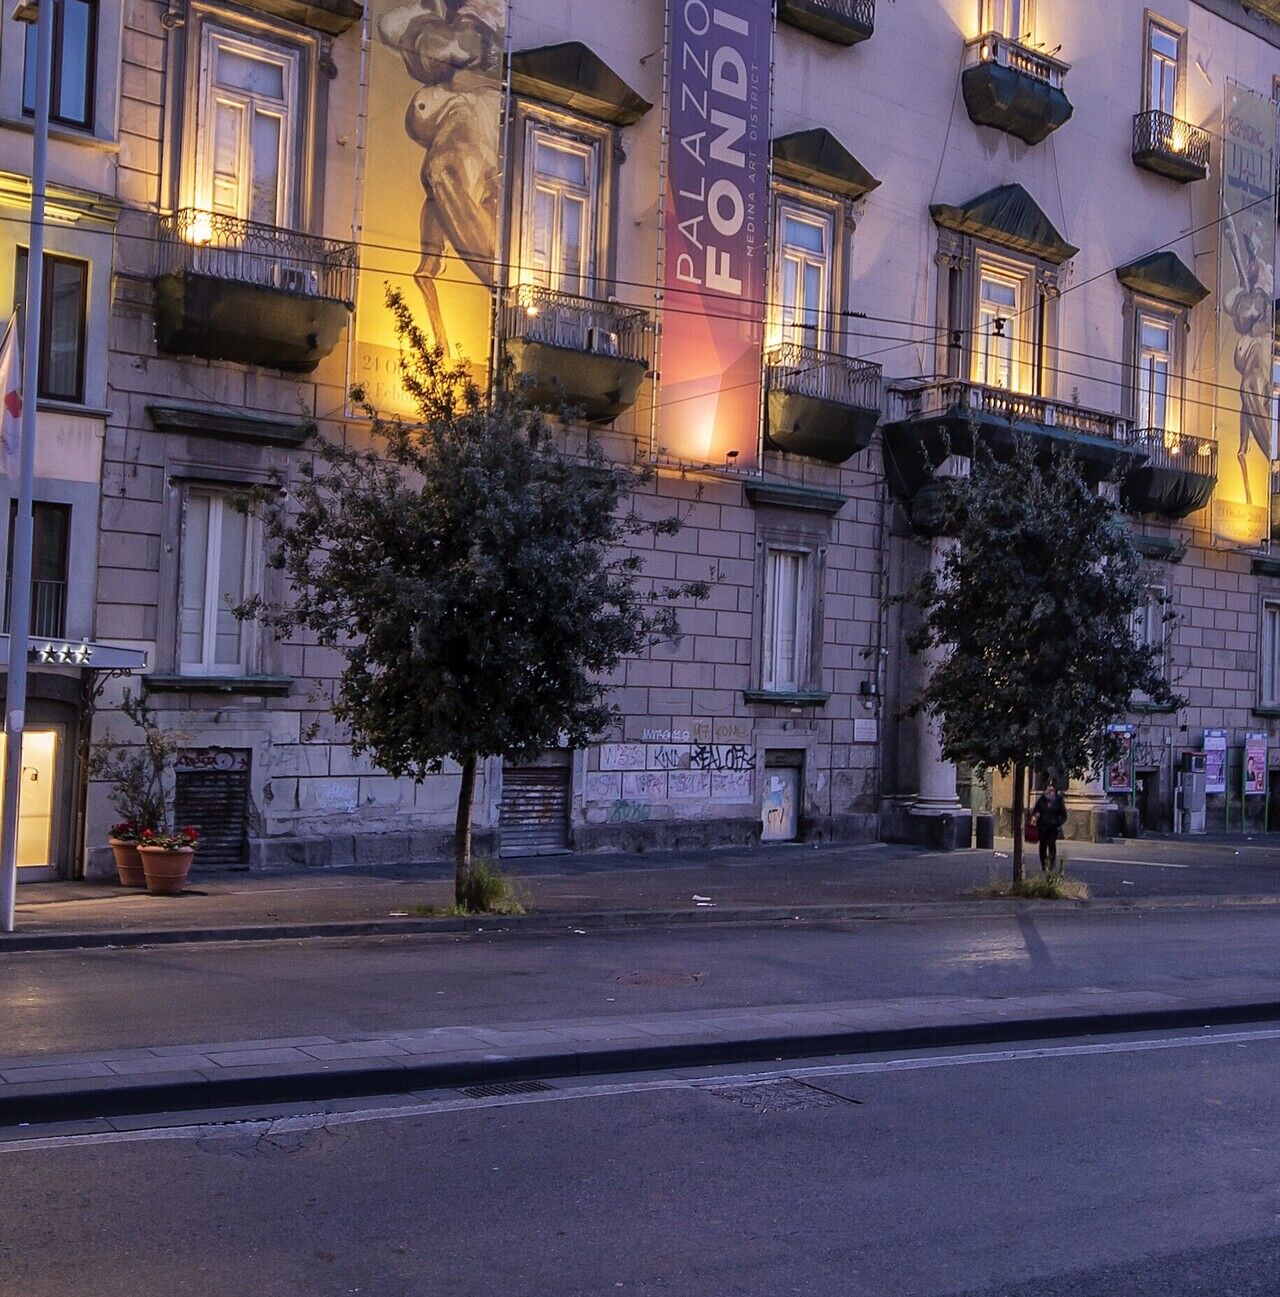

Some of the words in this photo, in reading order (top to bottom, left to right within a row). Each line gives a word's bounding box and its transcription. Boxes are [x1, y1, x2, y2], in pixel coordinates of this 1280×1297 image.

[749, 62, 759, 142] DISTRICT
[705, 8, 749, 296] FONDI
[748, 148, 757, 183] ART
[746, 191, 756, 257] MEDINA
